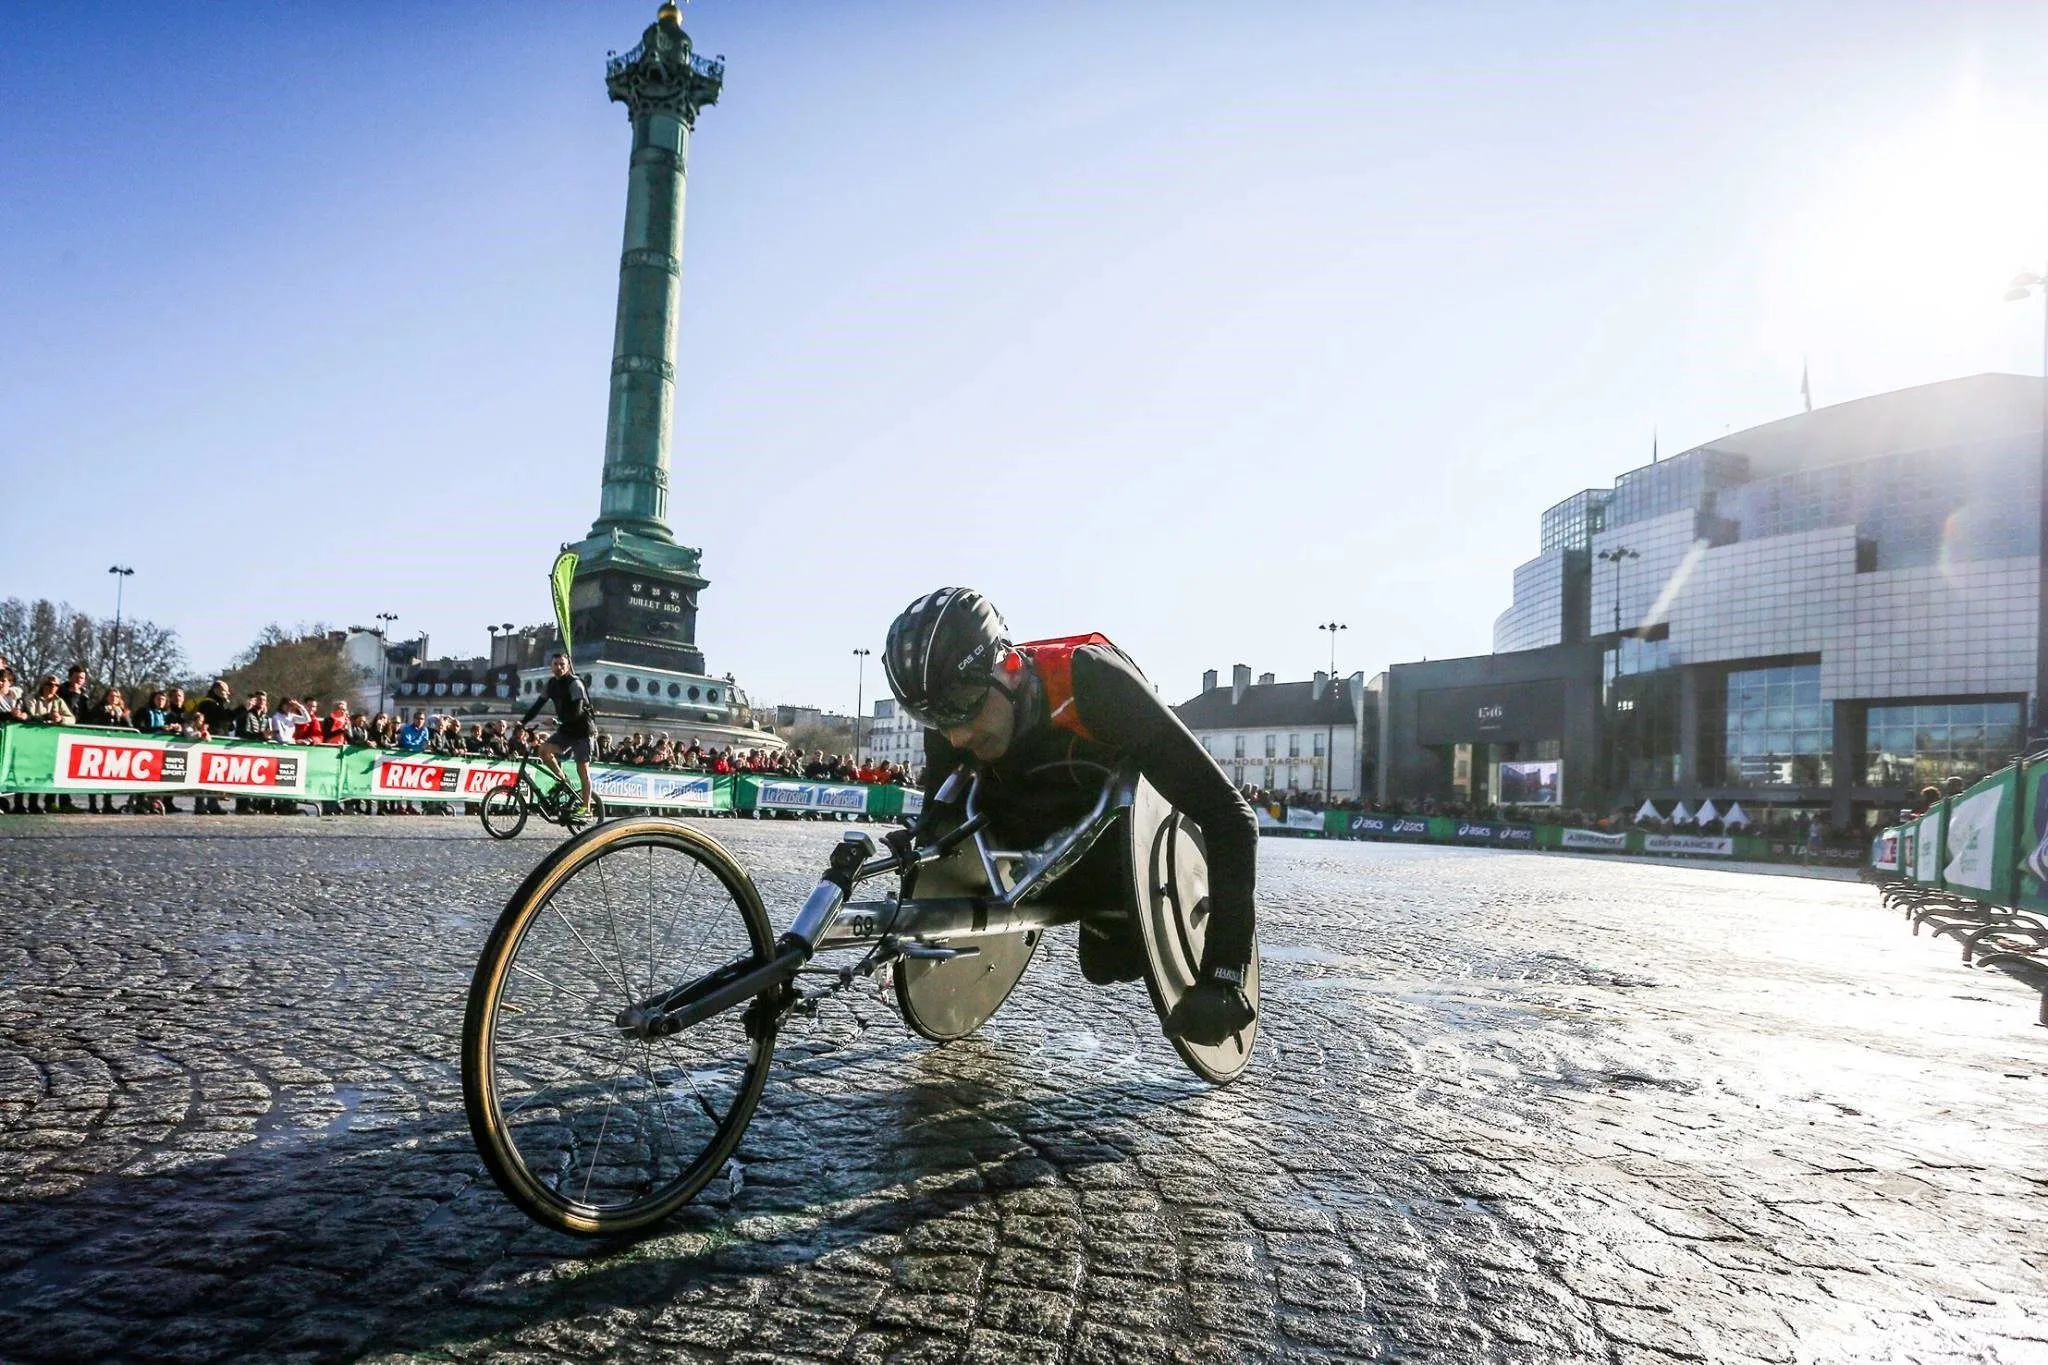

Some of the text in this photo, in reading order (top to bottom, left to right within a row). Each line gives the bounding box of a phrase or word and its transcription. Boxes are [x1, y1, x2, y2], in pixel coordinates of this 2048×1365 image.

[632, 583, 642, 592] 27
[629, 596, 661, 609] JUILLET
[77, 747, 154, 780] RMC
[161, 769, 187, 777] SPORT
[206, 755, 270, 785] RMC
[386, 764, 437, 789] RMC
[469, 772, 511, 792] RMC
[853, 914, 873, 937] 69
